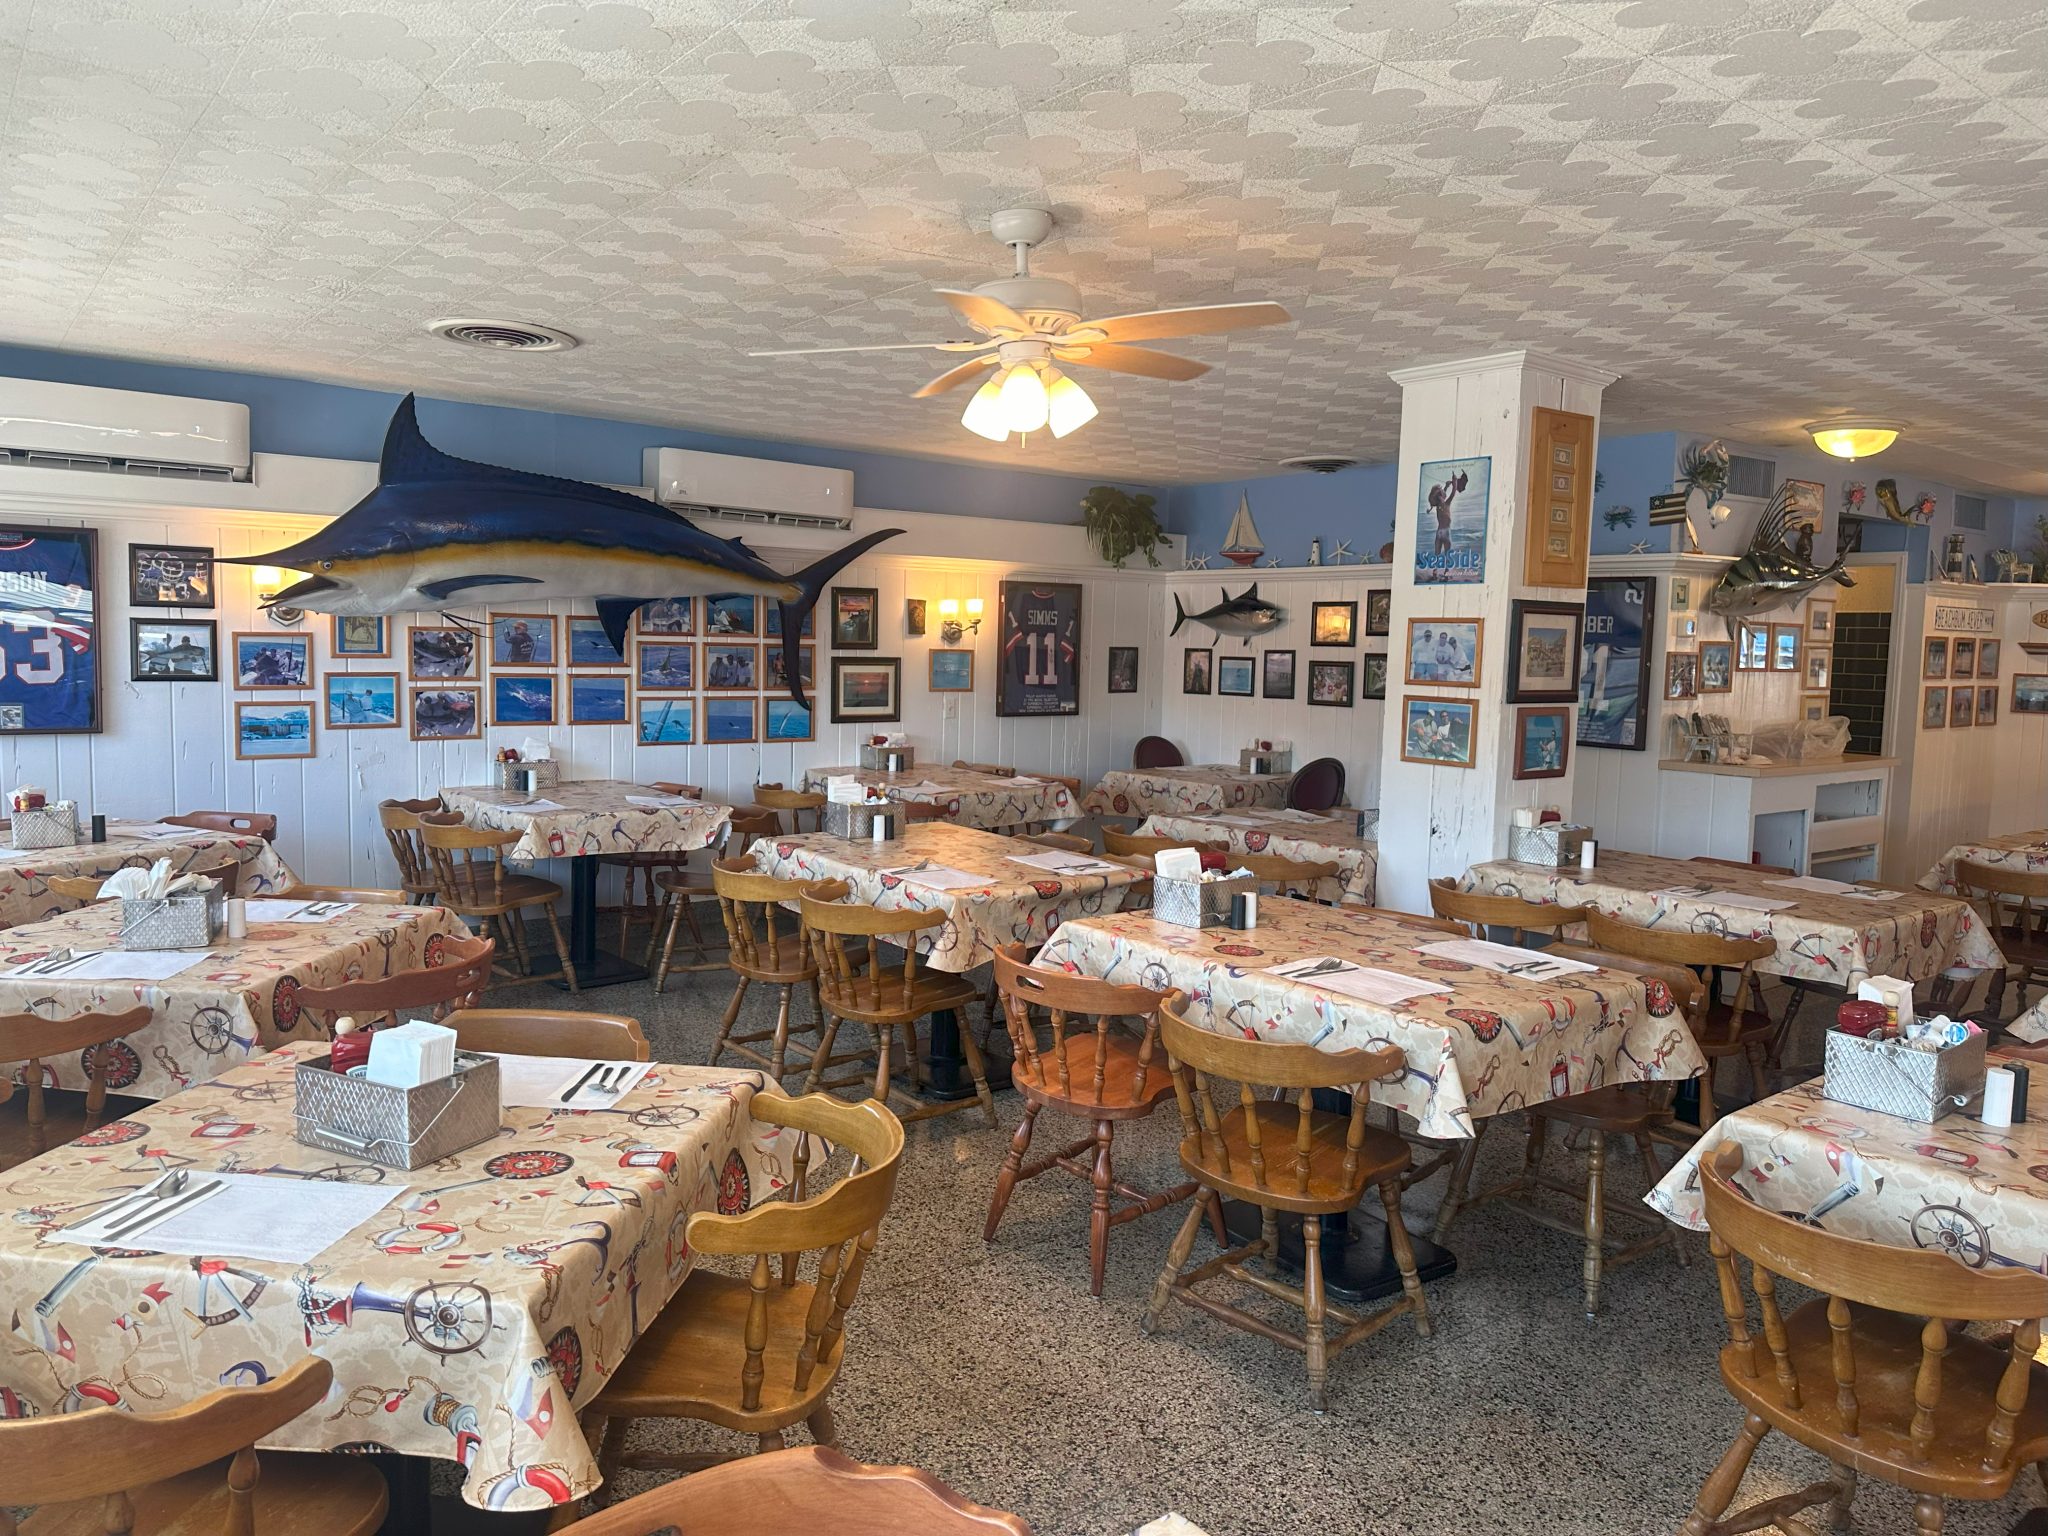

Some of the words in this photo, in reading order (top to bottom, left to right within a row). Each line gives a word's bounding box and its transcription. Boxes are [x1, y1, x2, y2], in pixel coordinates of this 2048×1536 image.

[1418, 549, 1481, 570] SeaSide
[1028, 610, 1058, 626] SIMMS
[1585, 615, 1614, 634] BER
[0, 610, 64, 684] 3
[1025, 632, 1058, 685] 11
